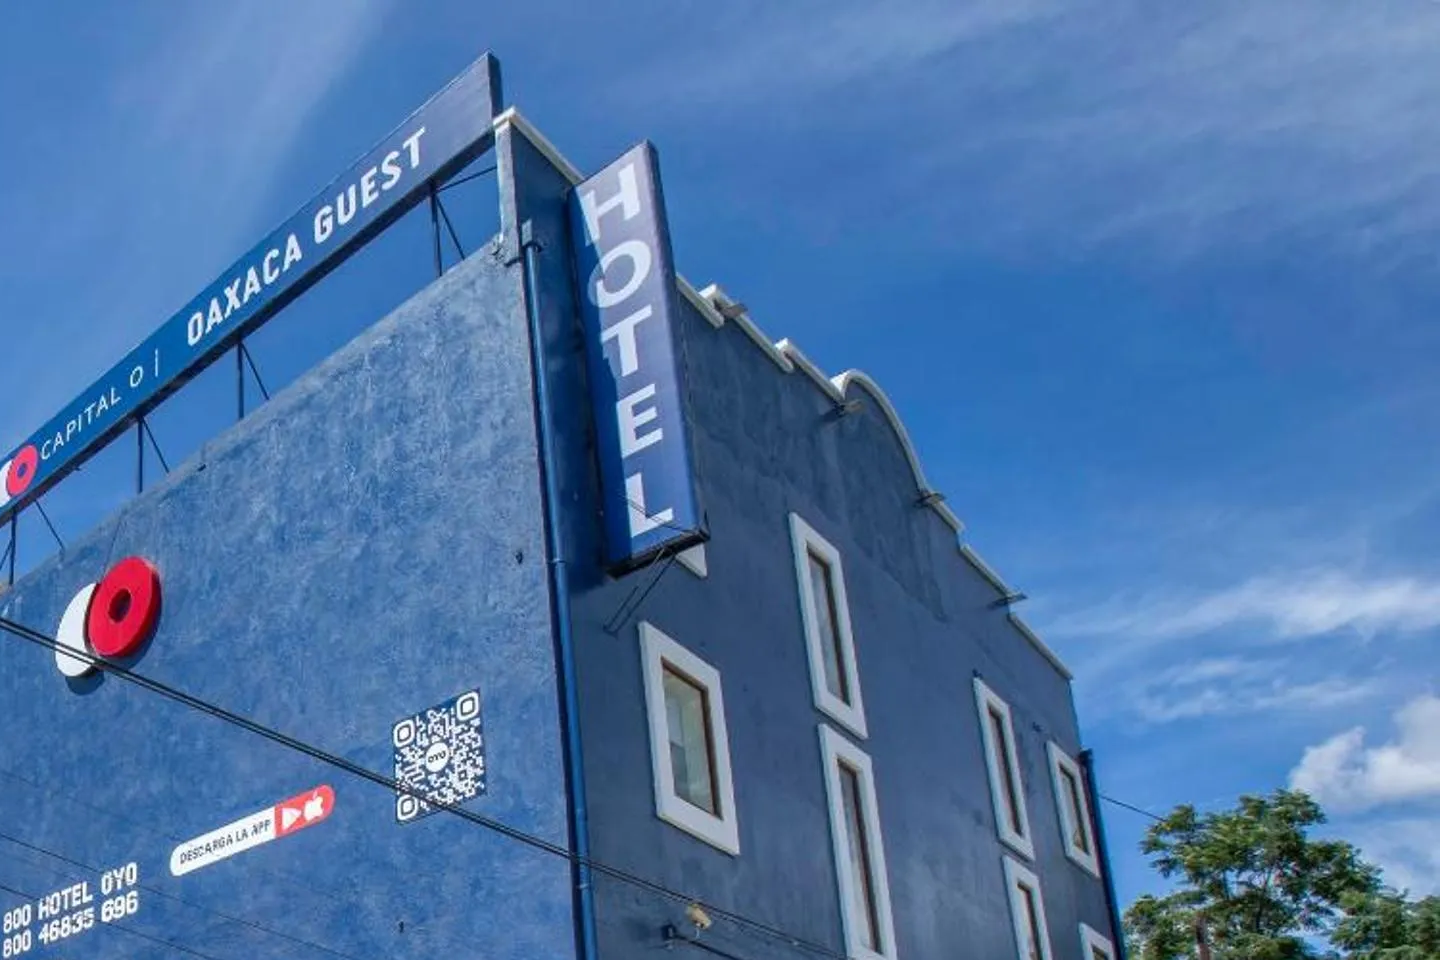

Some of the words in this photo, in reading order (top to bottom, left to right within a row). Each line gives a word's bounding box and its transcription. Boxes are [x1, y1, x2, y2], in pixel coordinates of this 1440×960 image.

[41, 387, 121, 460] CAPITAL
[129, 364, 144, 388] O
[187, 233, 303, 346] OAXACA
[314, 126, 426, 244] GUEST
[581, 162, 674, 537] HOTEL
[180, 834, 233, 864] DESCARGA
[235, 829, 249, 842] LA
[251, 819, 272, 837] APP
[3, 904, 31, 934] 800
[38, 881, 93, 920] HOTEL
[101, 862, 137, 895] OYO
[3, 929, 31, 958] 800
[38, 907, 94, 944] 46835
[101, 890, 138, 922] 696
